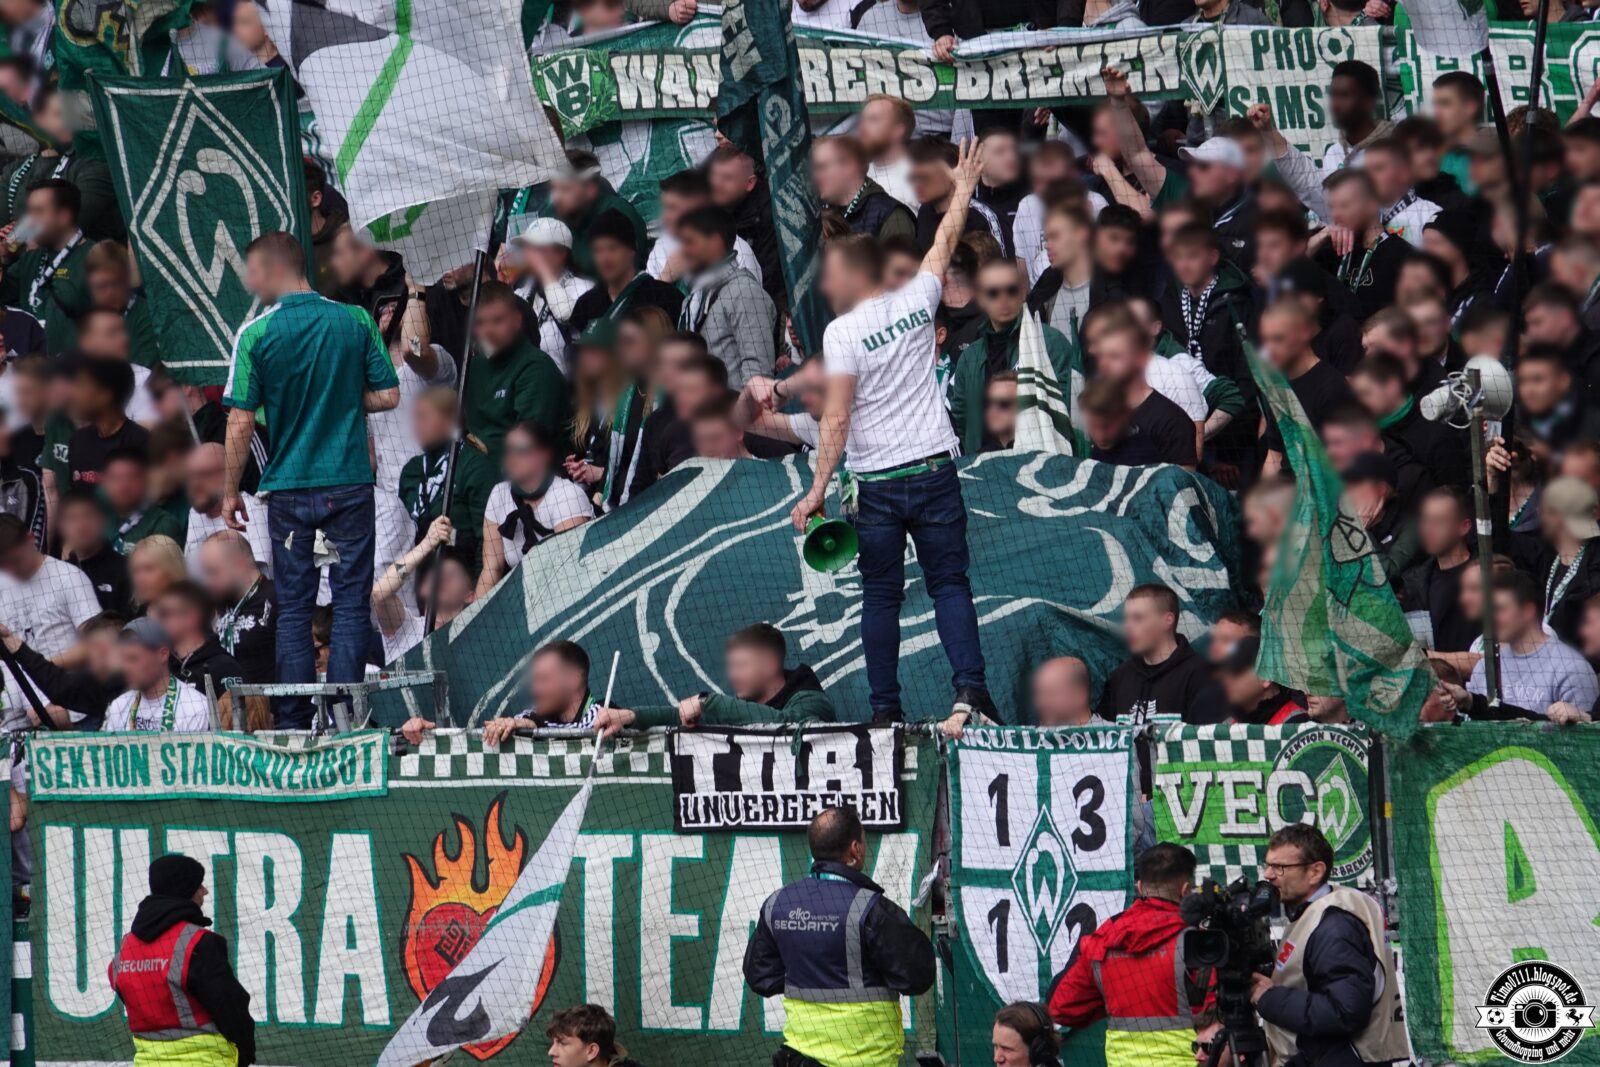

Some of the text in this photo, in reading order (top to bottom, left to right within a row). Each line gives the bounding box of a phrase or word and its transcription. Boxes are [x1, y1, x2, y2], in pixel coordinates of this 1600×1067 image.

[1250, 28, 1317, 71] PRO
[1229, 84, 1331, 129] SAMS
[862, 308, 932, 352] ULTRAS
[1022, 729, 1054, 750] LA
[1054, 729, 1132, 750] POLICE
[1283, 731, 1366, 762] SEKTION VECHTA
[38, 740, 377, 790] SEKTION STADIONVERBOT
[987, 773, 1107, 854] 1 3
[572, 832, 919, 1034] TEA
[774, 919, 840, 933] SECURITY
[117, 957, 169, 973] SECURITY
